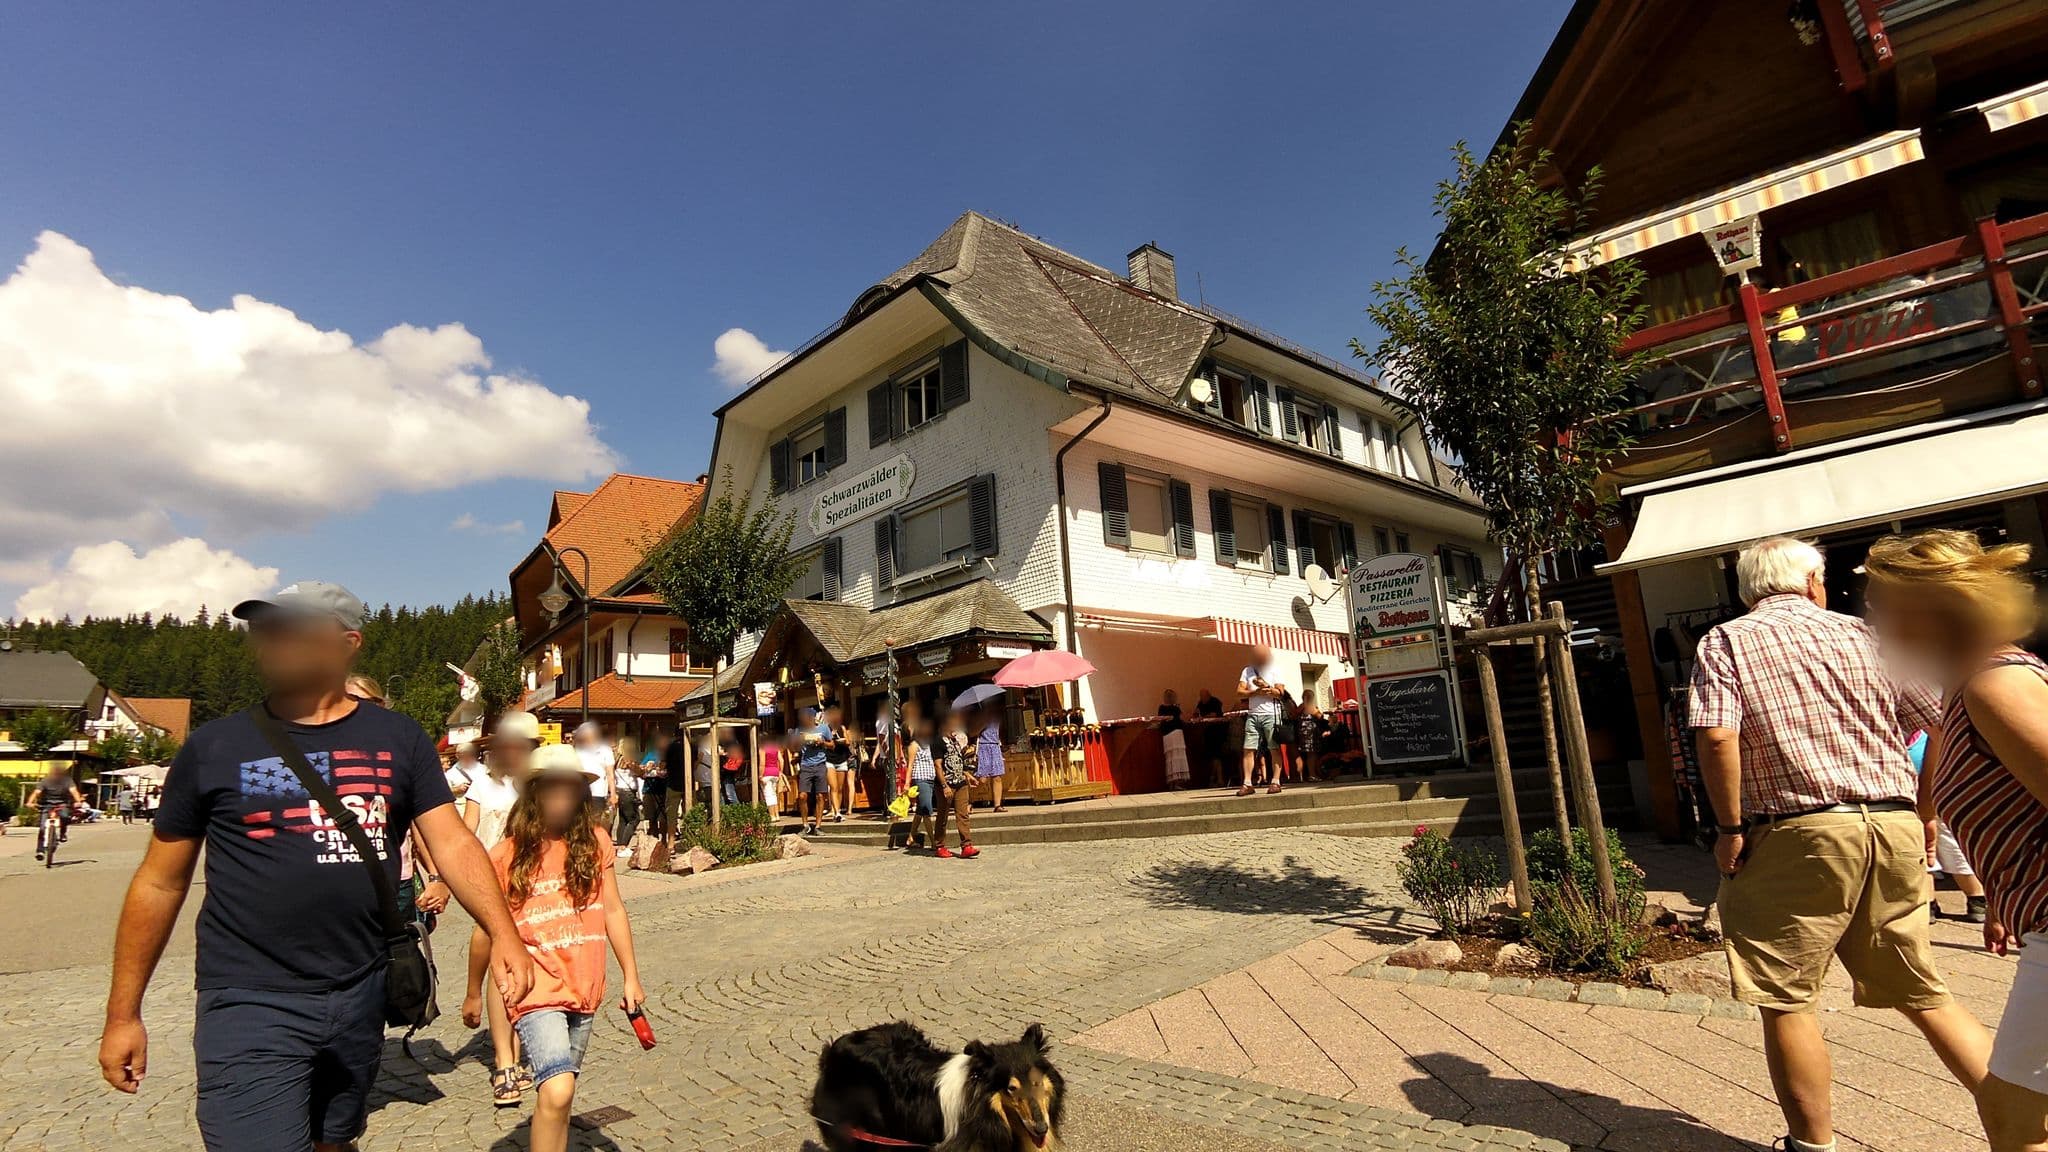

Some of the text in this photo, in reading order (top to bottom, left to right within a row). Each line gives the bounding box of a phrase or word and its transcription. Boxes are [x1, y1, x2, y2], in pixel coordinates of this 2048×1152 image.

[821, 466, 897, 509] Schwarzwälder
[826, 488, 892, 525] Spezialitäten
[1353, 557, 1424, 583] Passarella
[1360, 574, 1421, 594] RESTAURANT
[1370, 588, 1413, 603] PIZZERIA
[1399, 596, 1431, 606] Gerichte
[1378, 609, 1430, 628] Rothaus
[1376, 681, 1437, 702] Tageskarte
[342, 853, 364, 863] POL
